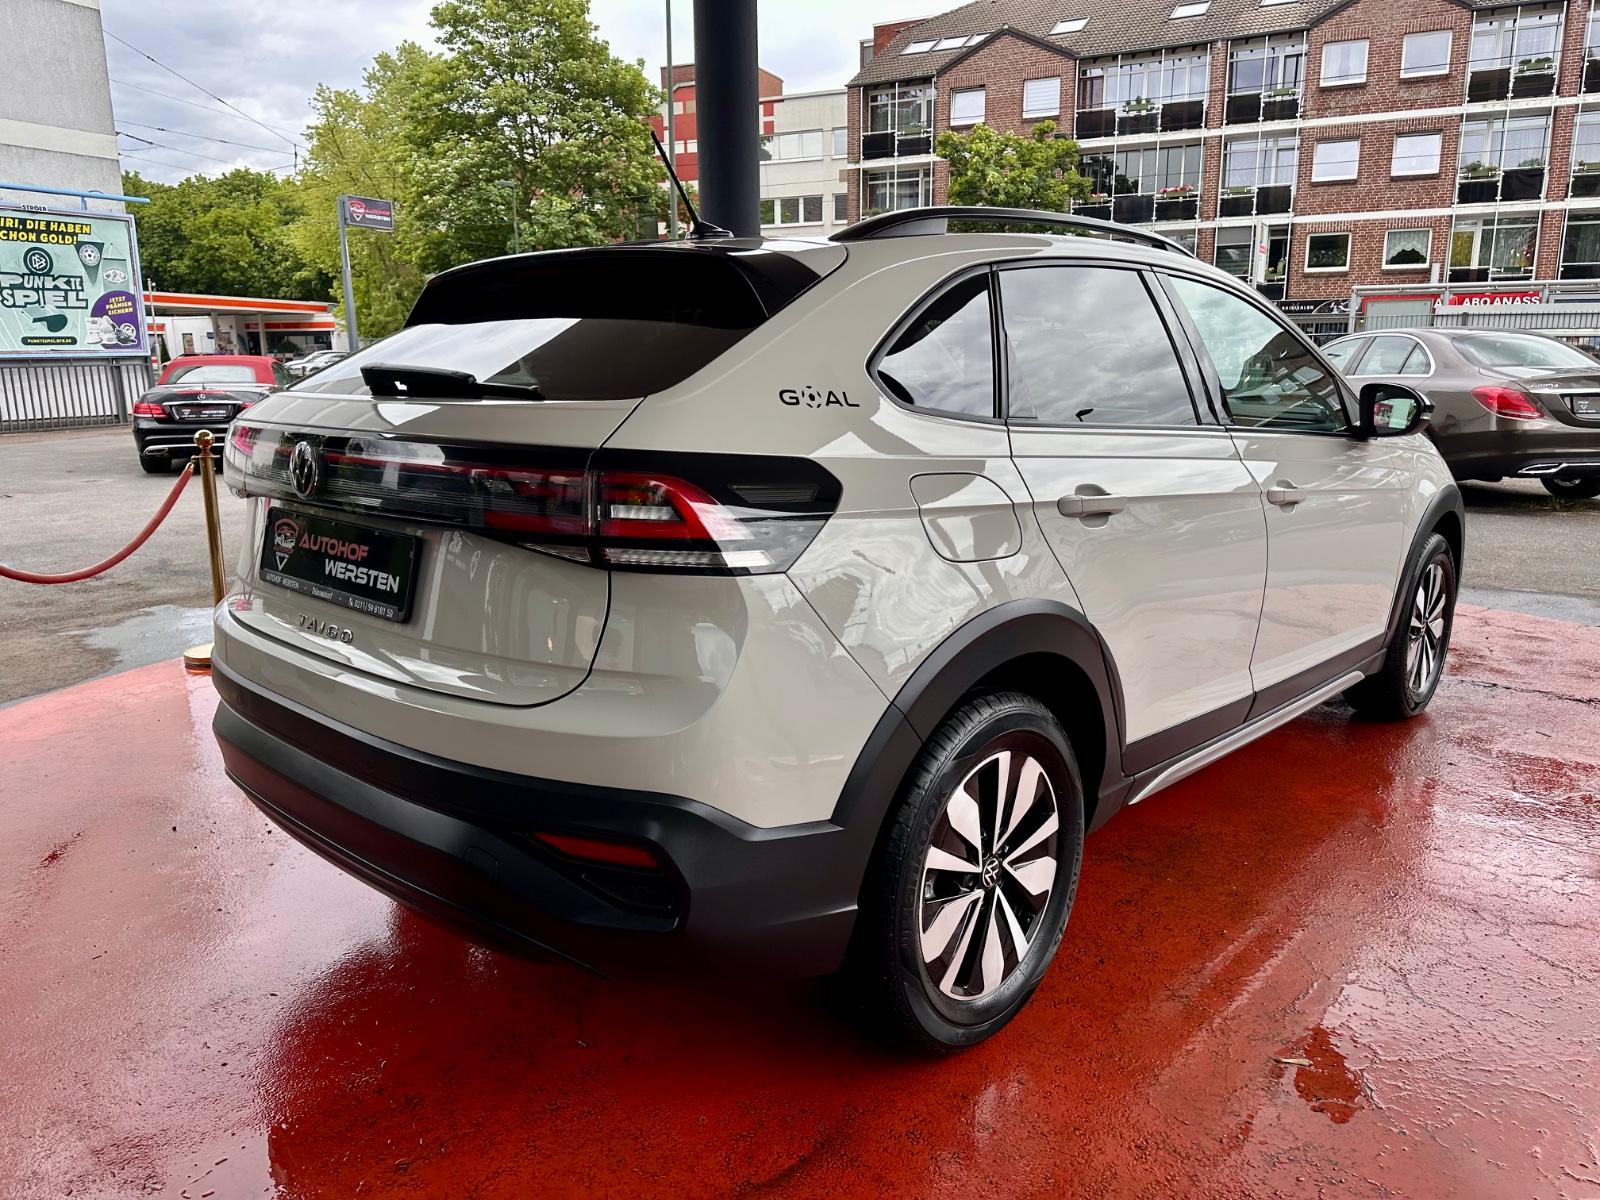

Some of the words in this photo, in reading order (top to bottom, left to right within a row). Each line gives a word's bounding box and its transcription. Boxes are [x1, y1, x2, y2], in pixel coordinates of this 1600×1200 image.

[26, 219, 46, 230] DIE
[50, 221, 91, 234] HABEN
[40, 233, 77, 245] GOLD!
[1, 289, 87, 308] SPIEL
[299, 531, 370, 562] AUTOHOF
[325, 558, 400, 594] WERSTEN
[299, 614, 355, 644] TAIGO
